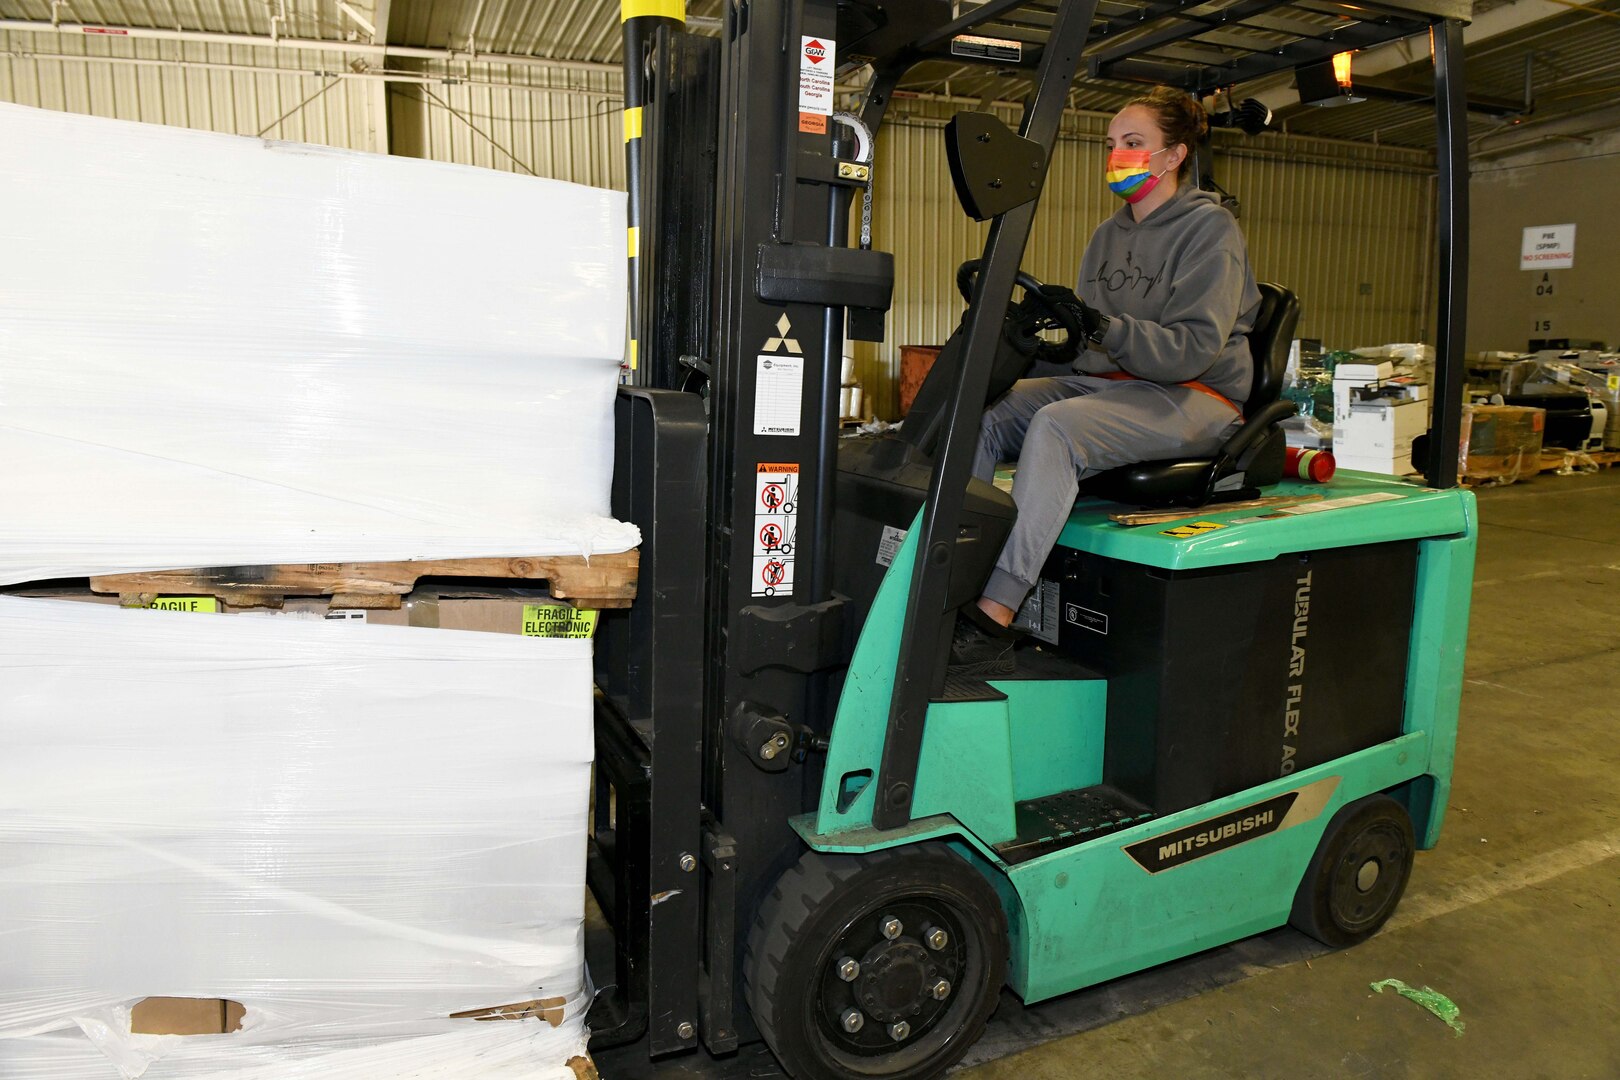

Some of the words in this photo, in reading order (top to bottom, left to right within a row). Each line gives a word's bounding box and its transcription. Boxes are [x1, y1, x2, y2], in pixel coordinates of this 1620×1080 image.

[812, 78, 830, 86] Carolina
[812, 85, 830, 93] Carolina
[1534, 252, 1572, 261] SCREENING
[1542, 272, 1549, 282] A
[1536, 285, 1553, 296] 04
[537, 608, 582, 620] FRAGILE
[525, 621, 591, 633] ELECTRONIC
[1289, 569, 1312, 678] TUBULAR
[1283, 684, 1302, 738] FLEX
[1158, 810, 1273, 861] MITSUBISHI
